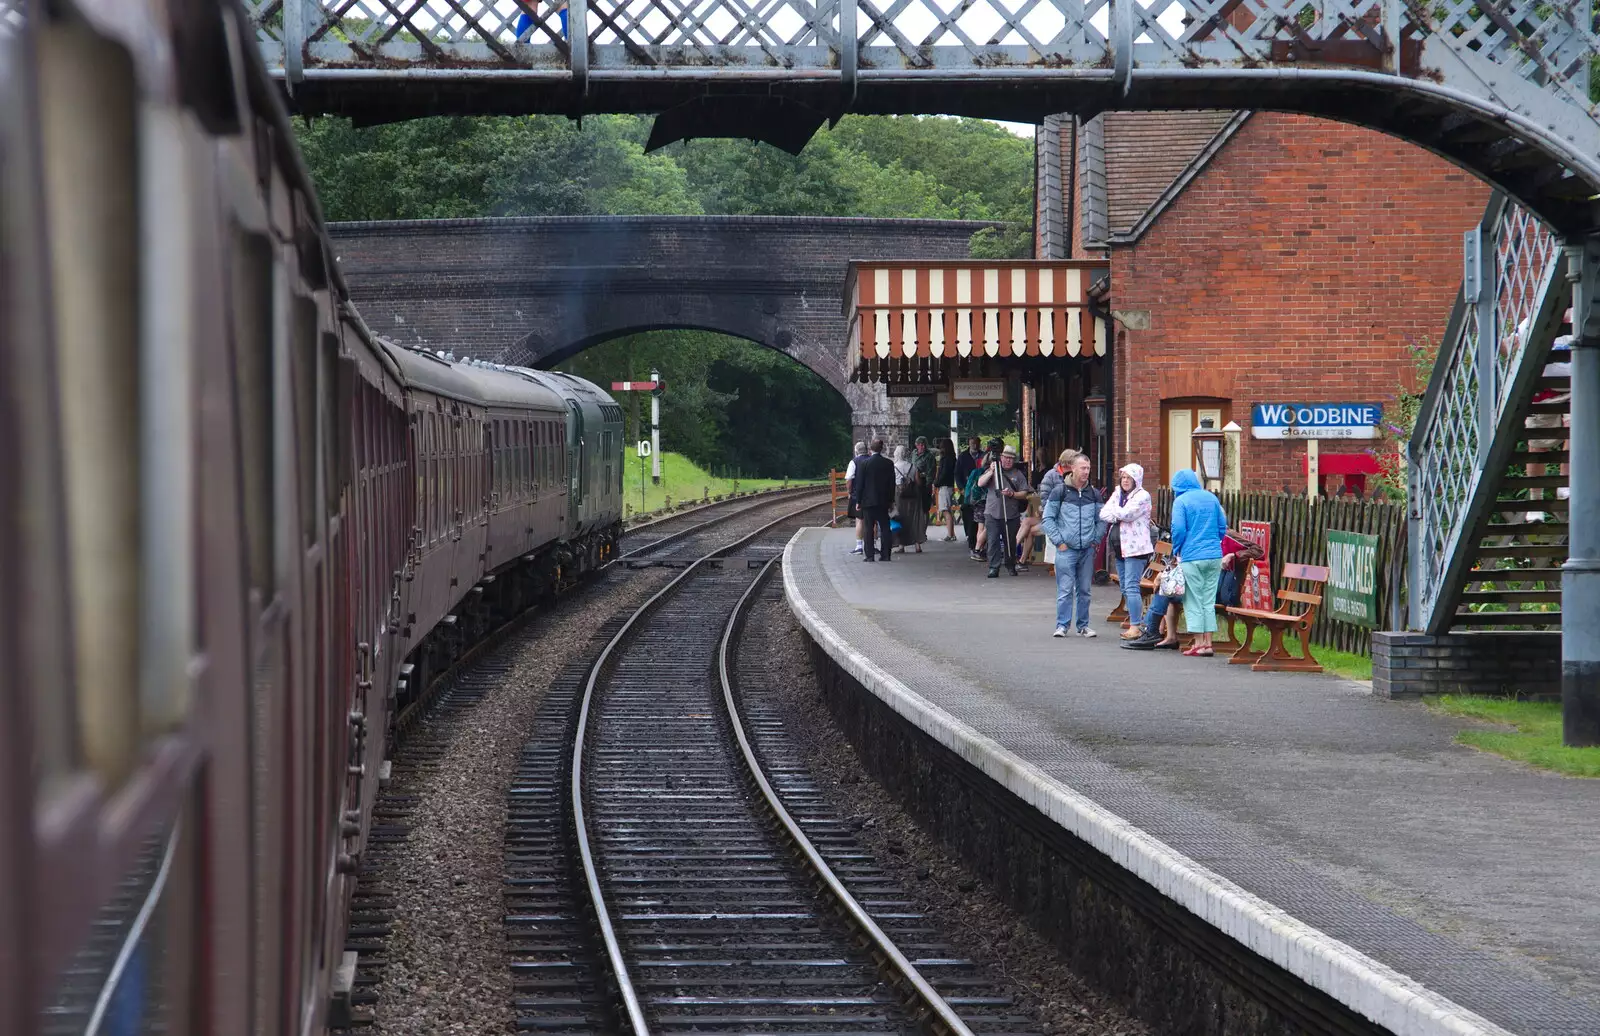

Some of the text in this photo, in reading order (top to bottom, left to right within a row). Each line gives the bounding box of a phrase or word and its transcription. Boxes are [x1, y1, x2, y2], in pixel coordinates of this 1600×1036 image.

[1260, 404, 1374, 425] WOODBINE
[1281, 428, 1353, 436] CIGARETTES
[638, 440, 651, 457] 10
[1355, 545, 1376, 596] ALES
